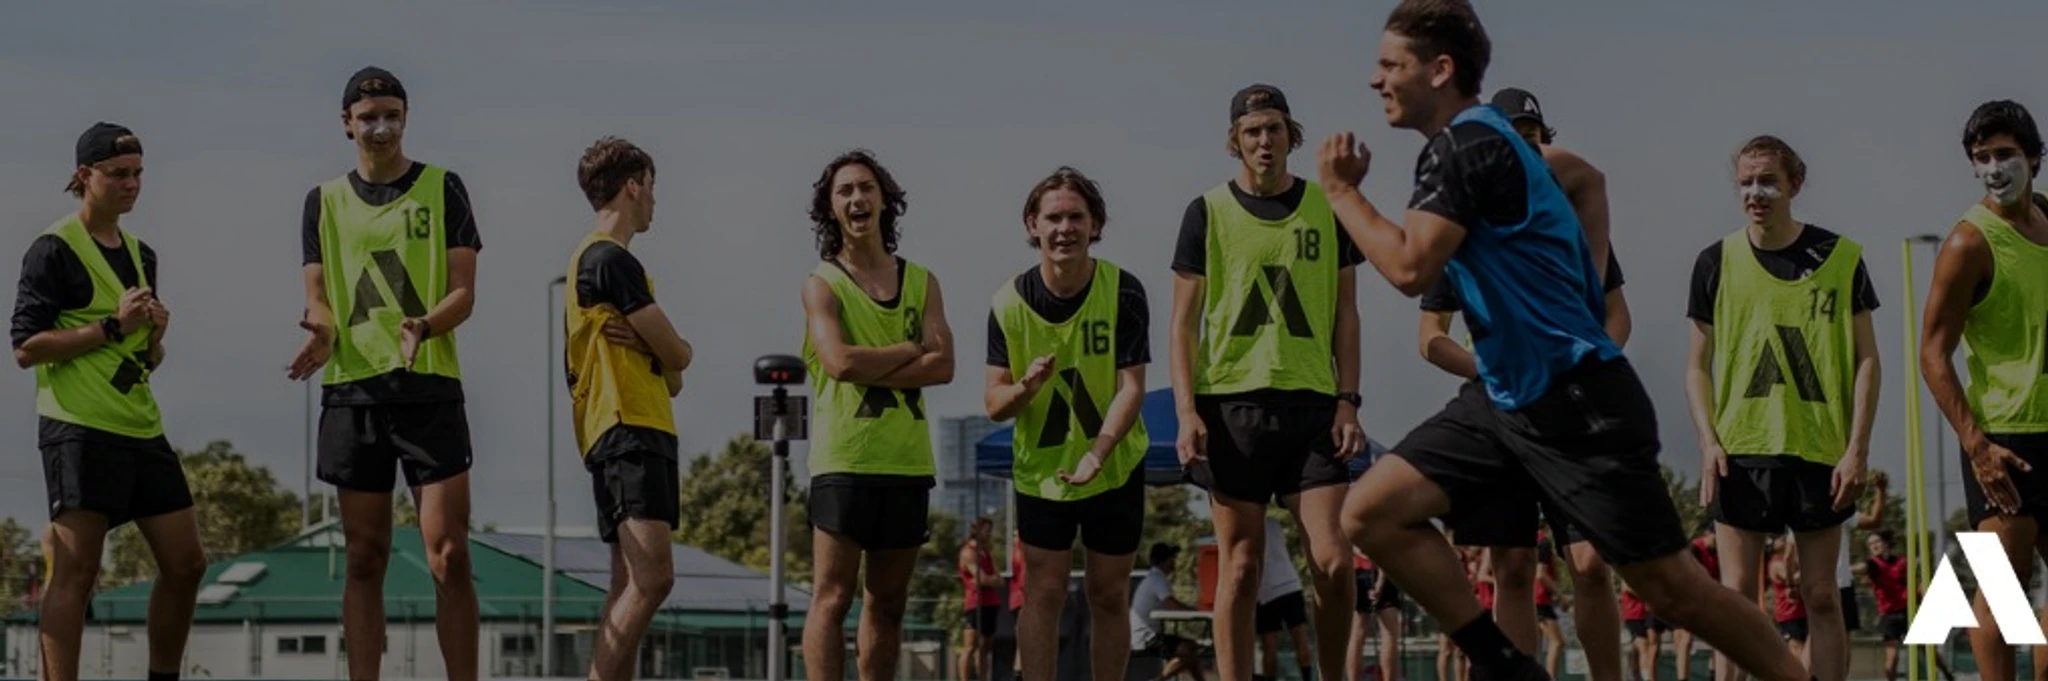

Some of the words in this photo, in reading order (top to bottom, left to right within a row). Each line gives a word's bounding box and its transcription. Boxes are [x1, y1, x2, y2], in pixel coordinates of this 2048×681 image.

[404, 207, 430, 240] 13
[1294, 228, 1320, 261] 18
[1811, 287, 1837, 323] 14
[1082, 321, 1110, 355] 16
